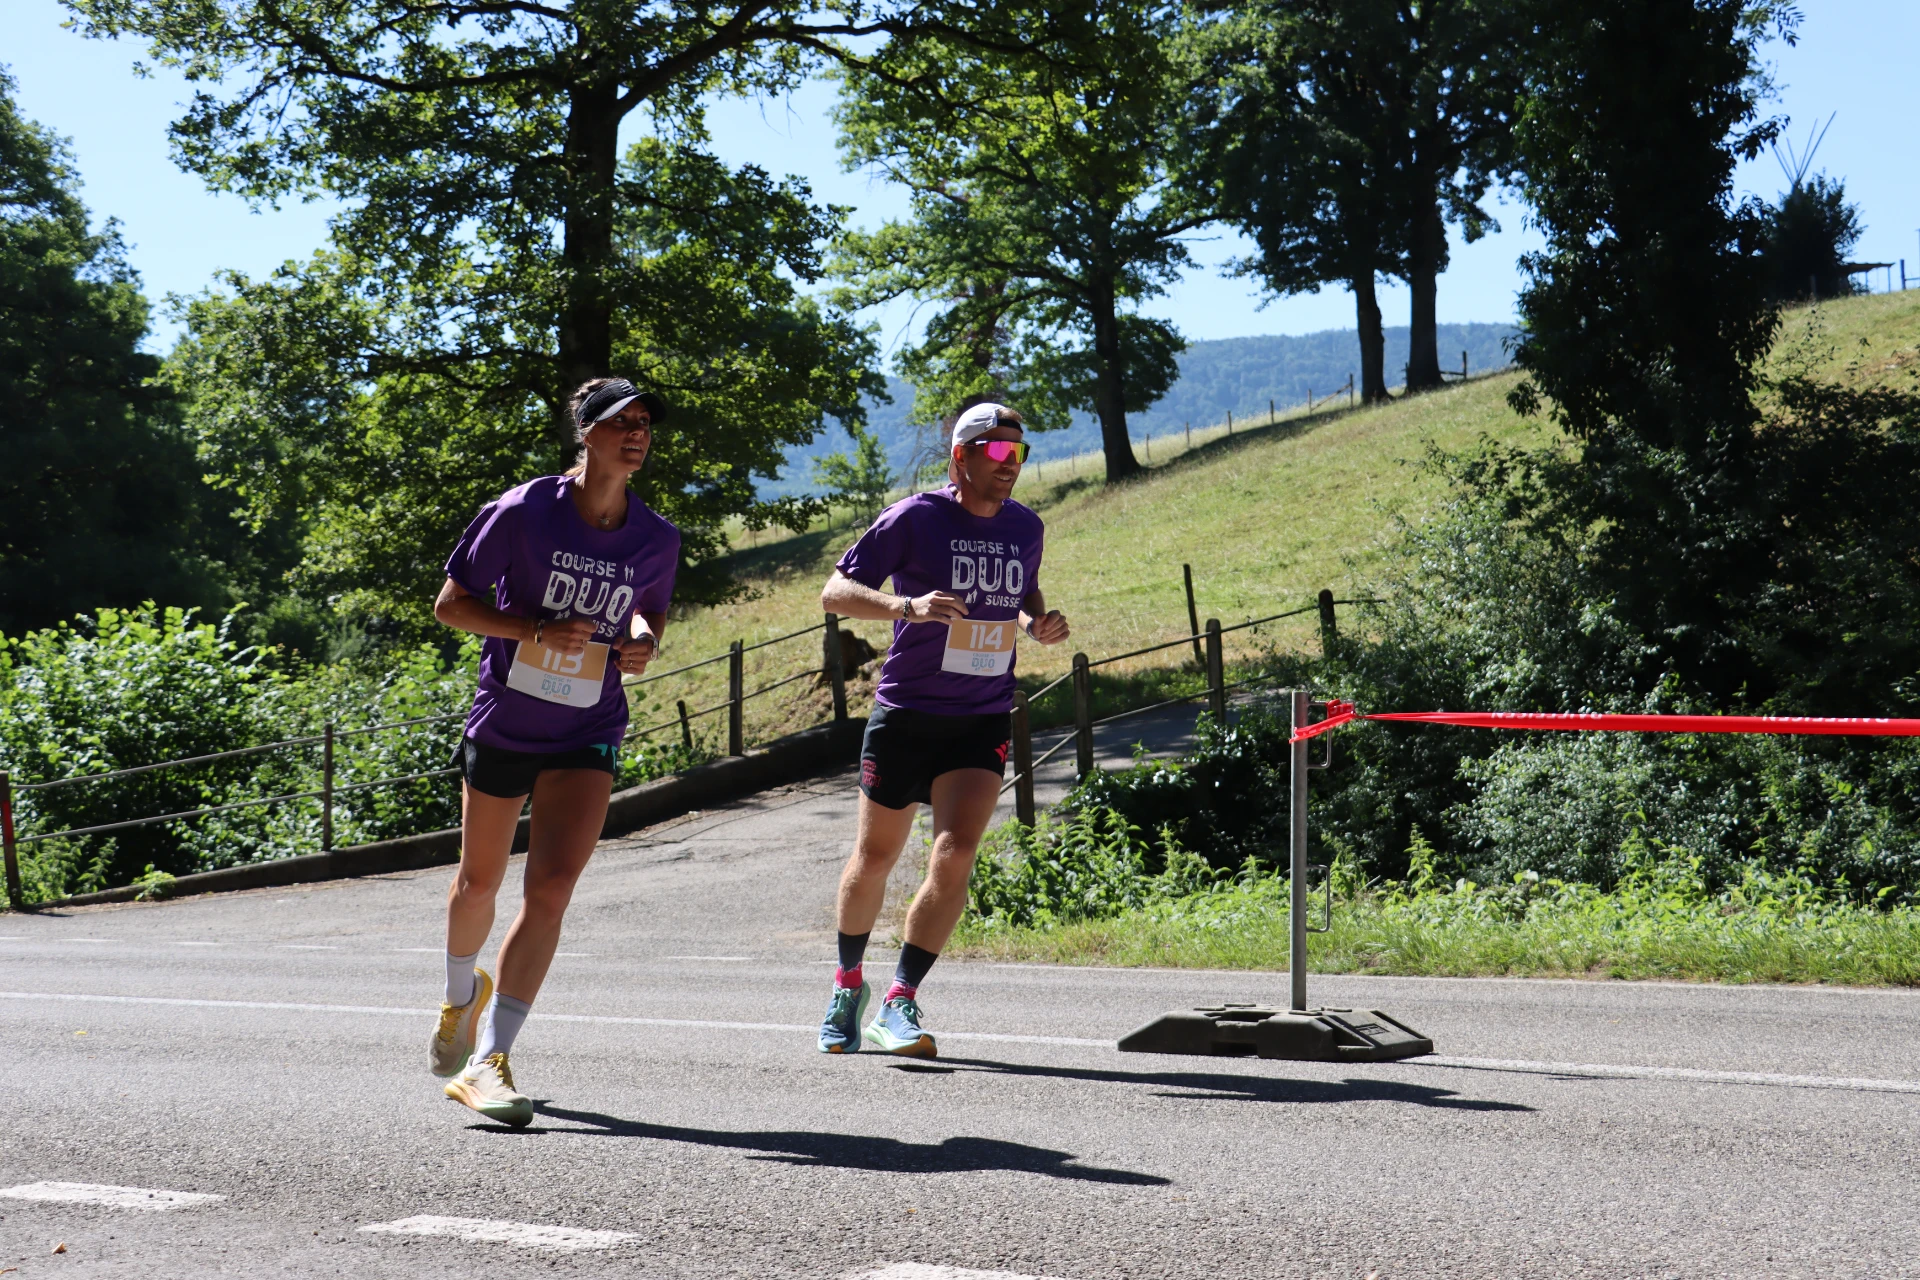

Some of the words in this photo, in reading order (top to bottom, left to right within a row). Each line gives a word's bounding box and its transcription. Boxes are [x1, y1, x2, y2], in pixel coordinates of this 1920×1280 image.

[951, 540, 1004, 554] COURSE
[552, 551, 616, 578] COURSE
[952, 556, 1023, 594] DUO
[542, 571, 633, 624] DUO
[985, 594, 1020, 607] SUISSE
[969, 624, 1002, 649] 114
[541, 647, 584, 674] 113
[971, 657, 994, 667] DUO
[541, 678, 571, 695] DUO
